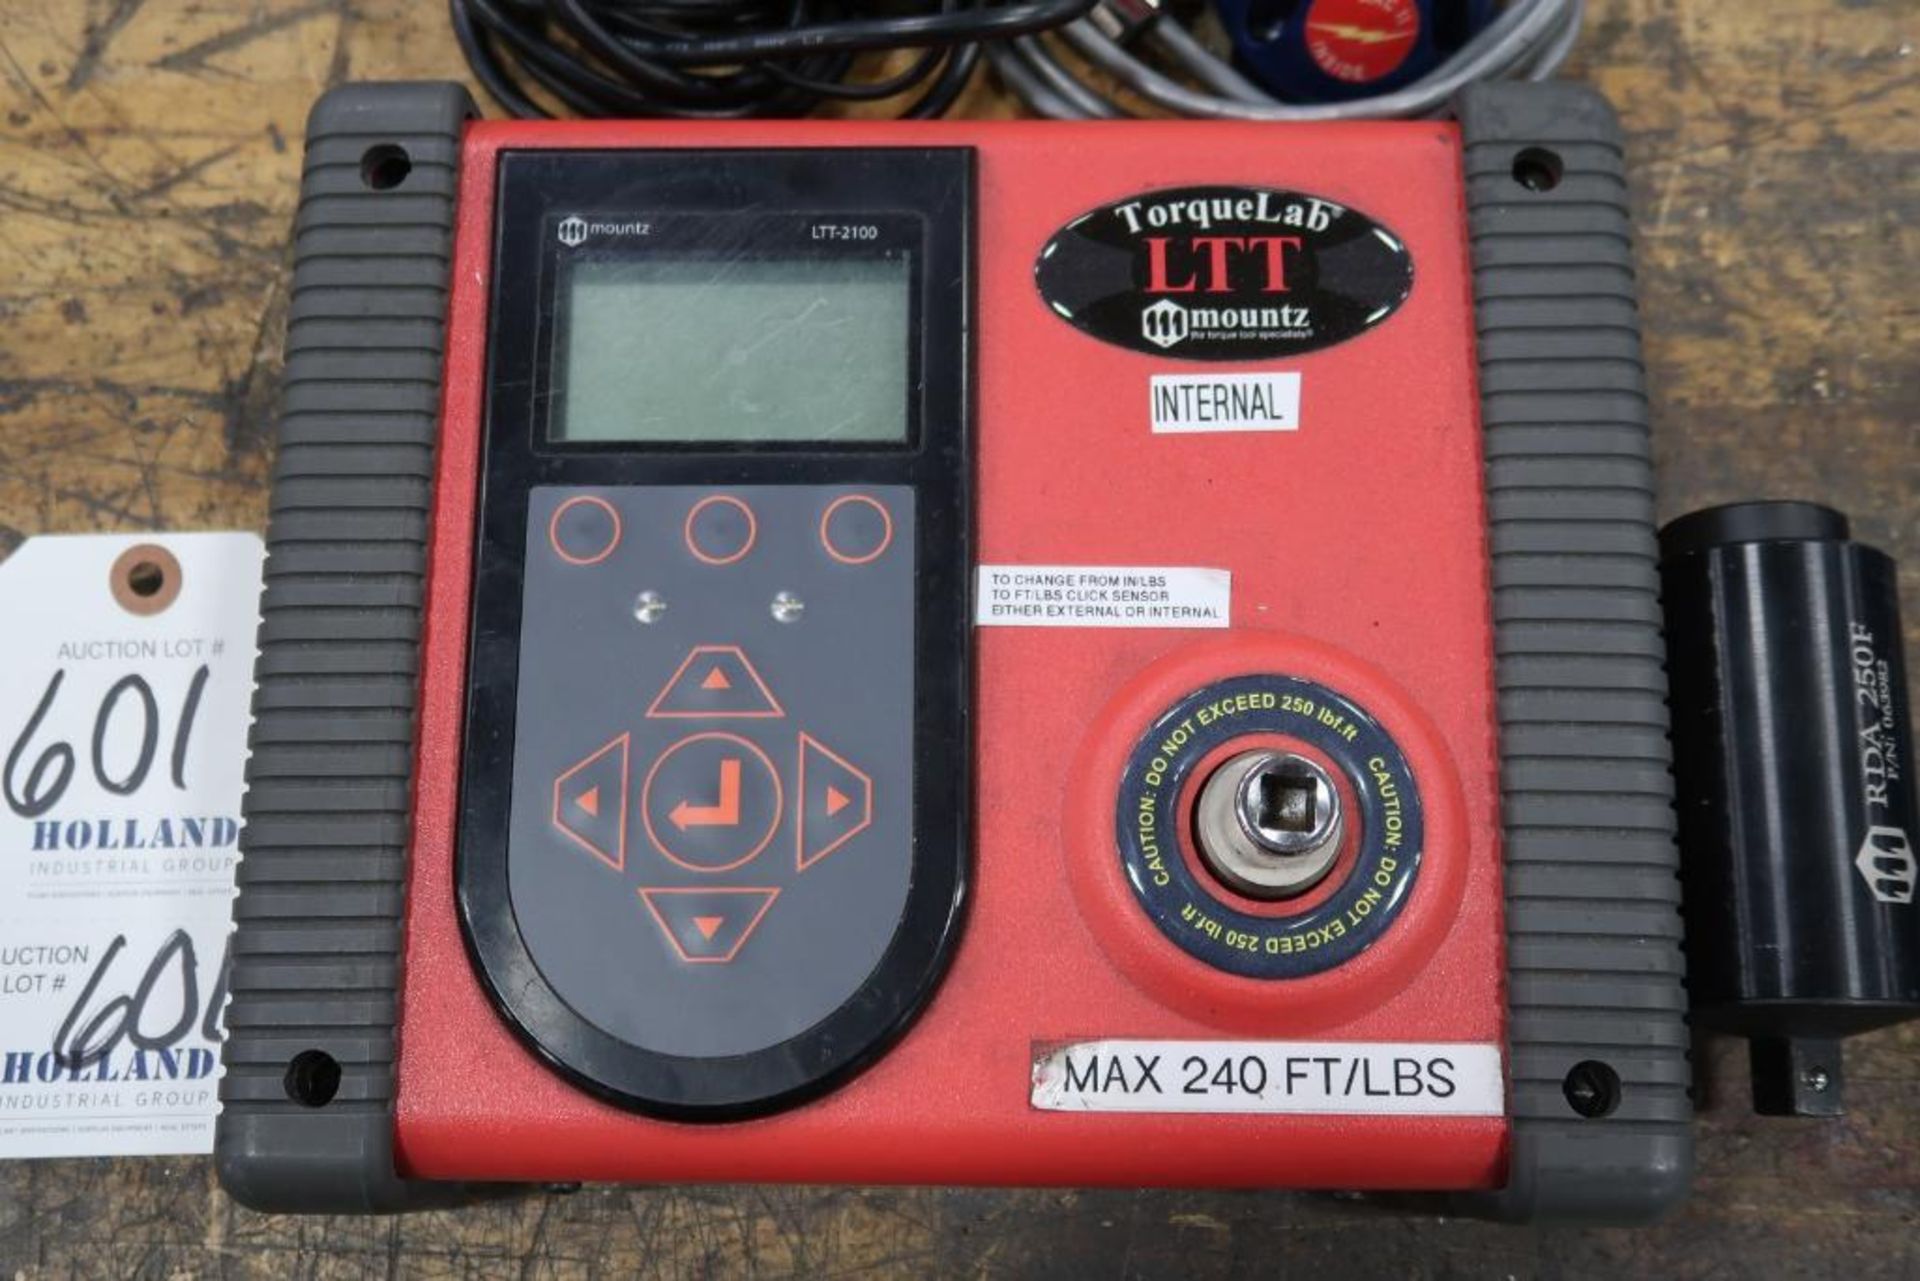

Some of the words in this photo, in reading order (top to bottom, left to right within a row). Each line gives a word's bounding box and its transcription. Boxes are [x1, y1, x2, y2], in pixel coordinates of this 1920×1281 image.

[590, 221, 650, 235] mountz
[811, 224, 878, 240] LTT-2100
[1143, 236, 1303, 293] LTT
[1190, 304, 1310, 329] mountz
[1153, 383, 1283, 422] INTERNAL
[992, 574, 1010, 586] TO
[1014, 574, 1074, 587] CHANGE
[1080, 575, 1120, 587] FROM
[1123, 576, 1166, 588] IN/LBS
[992, 589, 1010, 601] TO
[1014, 589, 1063, 601] FT/LBS
[1066, 589, 1108, 602] CLICK
[1112, 590, 1169, 602] SENSOR
[991, 604, 1042, 617] EITHER
[1049, 604, 1120, 618] EXTERNAL
[1125, 606, 1146, 618] OR
[1149, 606, 1220, 619] INTERNAL
[57, 640, 156, 660] AUCTION
[164, 639, 203, 658] LOT
[211, 639, 225, 657] #
[1849, 621, 1878, 709] 250F
[1197, 693, 1275, 726] EXCEED
[1281, 696, 1314, 717] 250
[3, 664, 209, 819] 601
[1161, 720, 1196, 757] NOT
[1146, 757, 1168, 786] DO
[1859, 722, 1889, 808] RDA
[1368, 757, 1403, 854] CAUTION:
[31, 816, 238, 850] HOLLAND
[1139, 790, 1170, 886] CAUTION:
[29, 858, 150, 877] INDUSTRIAL
[163, 857, 233, 872] GROUP
[1375, 857, 1396, 887] DO
[1346, 887, 1382, 927] NOT
[1226, 930, 1260, 951] 250
[1266, 919, 1346, 954] EXCEED
[1, 946, 89, 966] UCTION
[3, 974, 47, 993] LOT
[52, 974, 66, 993] #
[1, 1048, 215, 1084] HOLLAND
[1063, 1055, 1162, 1093] MAX
[1182, 1056, 1268, 1095] 240
[1286, 1057, 1456, 1097] FT/LBS
[136, 1091, 210, 1107] GROUP
